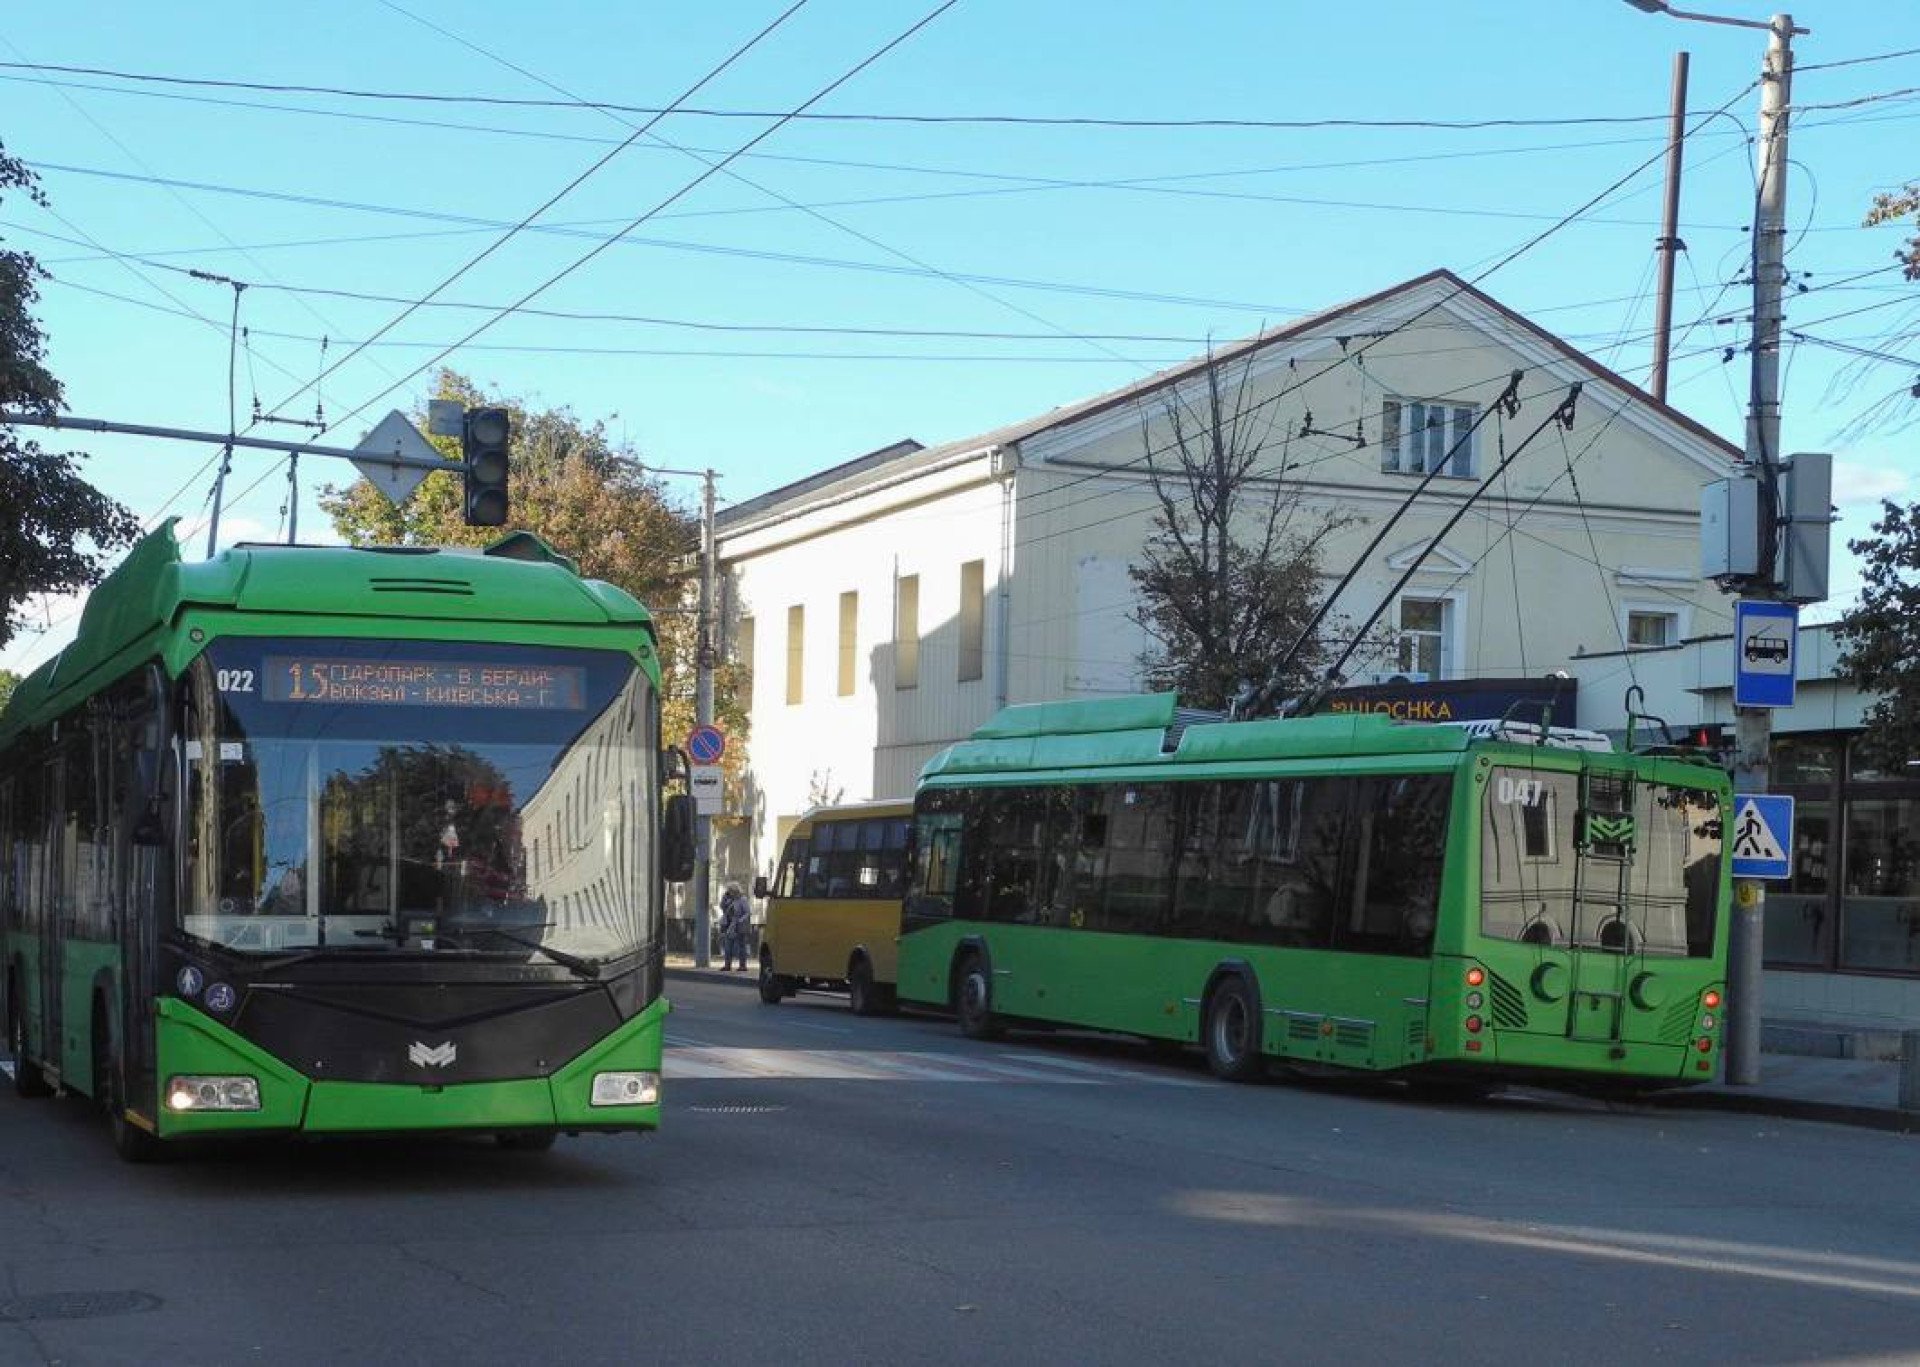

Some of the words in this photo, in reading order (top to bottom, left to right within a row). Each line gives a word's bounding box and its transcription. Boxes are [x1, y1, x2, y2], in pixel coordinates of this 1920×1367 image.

[216, 670, 254, 692] 022
[289, 663, 328, 699] 15
[330, 684, 406, 701] ВОКЗАЛ
[1498, 777, 1543, 807] 047
